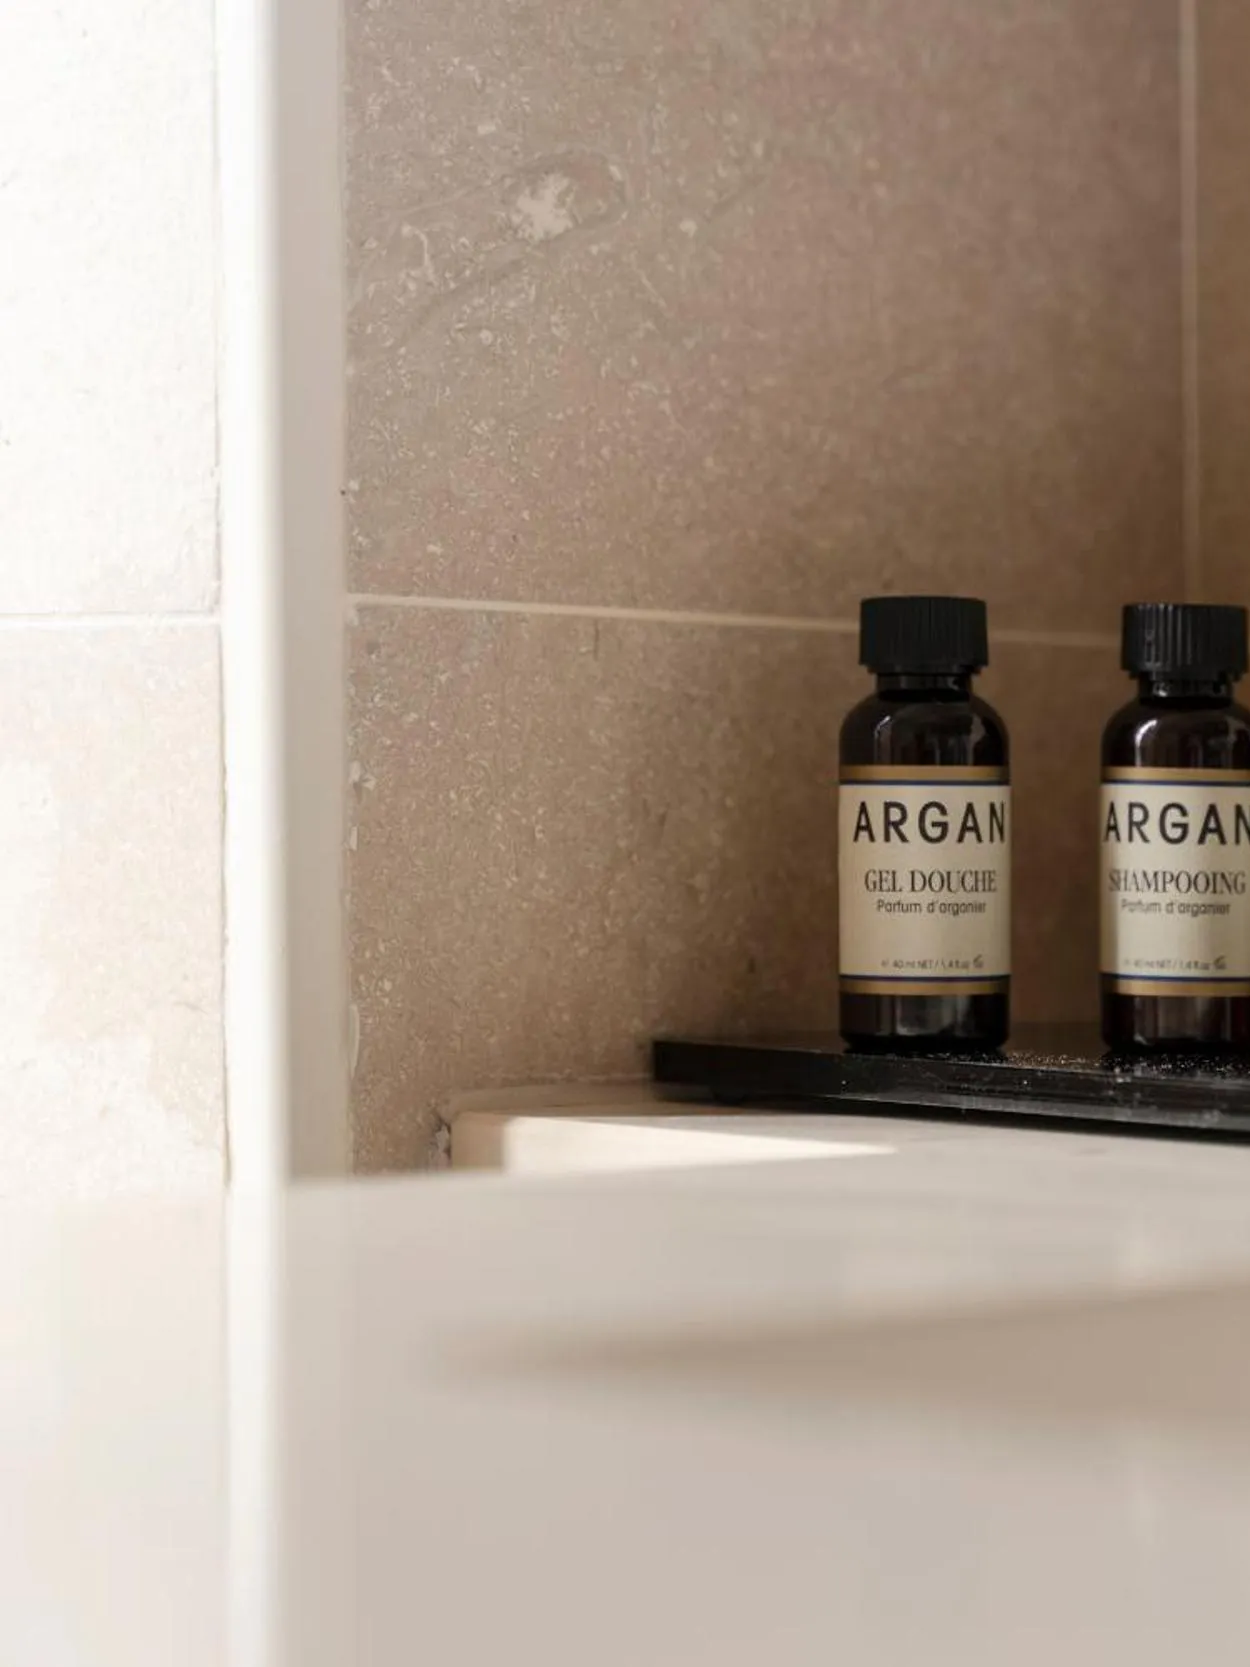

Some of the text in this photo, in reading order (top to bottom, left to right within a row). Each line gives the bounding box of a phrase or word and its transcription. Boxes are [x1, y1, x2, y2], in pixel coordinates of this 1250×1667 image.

[852, 800, 1005, 844] ARGAN
[864, 868, 998, 893] GEL DOUCHE
[1108, 867, 1247, 895] SHAMPOOING
[876, 898, 987, 917] Parfum d'arganier
